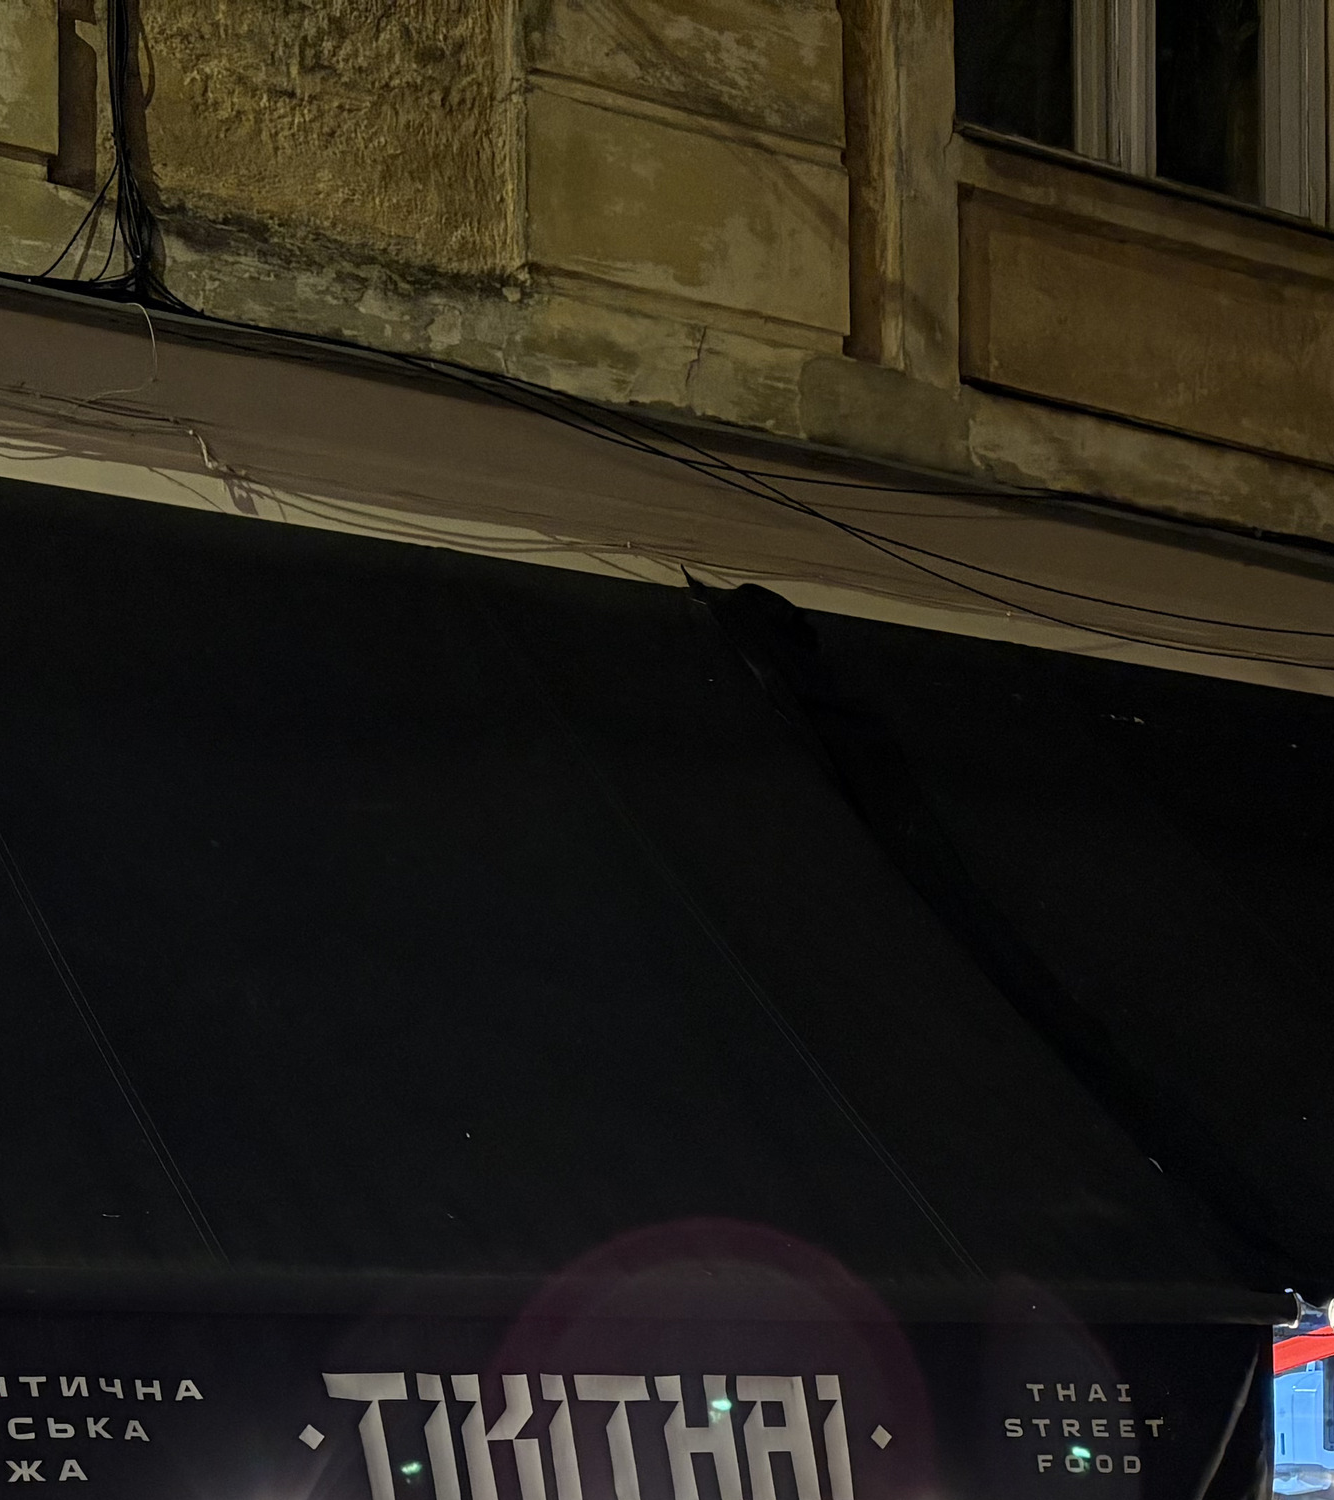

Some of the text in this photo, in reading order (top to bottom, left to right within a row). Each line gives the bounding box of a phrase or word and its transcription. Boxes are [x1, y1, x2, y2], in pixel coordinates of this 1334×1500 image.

[1025, 1383, 1134, 1403] THAI
[1004, 1417, 1165, 1439] STREET
[1037, 1454, 1142, 1474] FOOD
